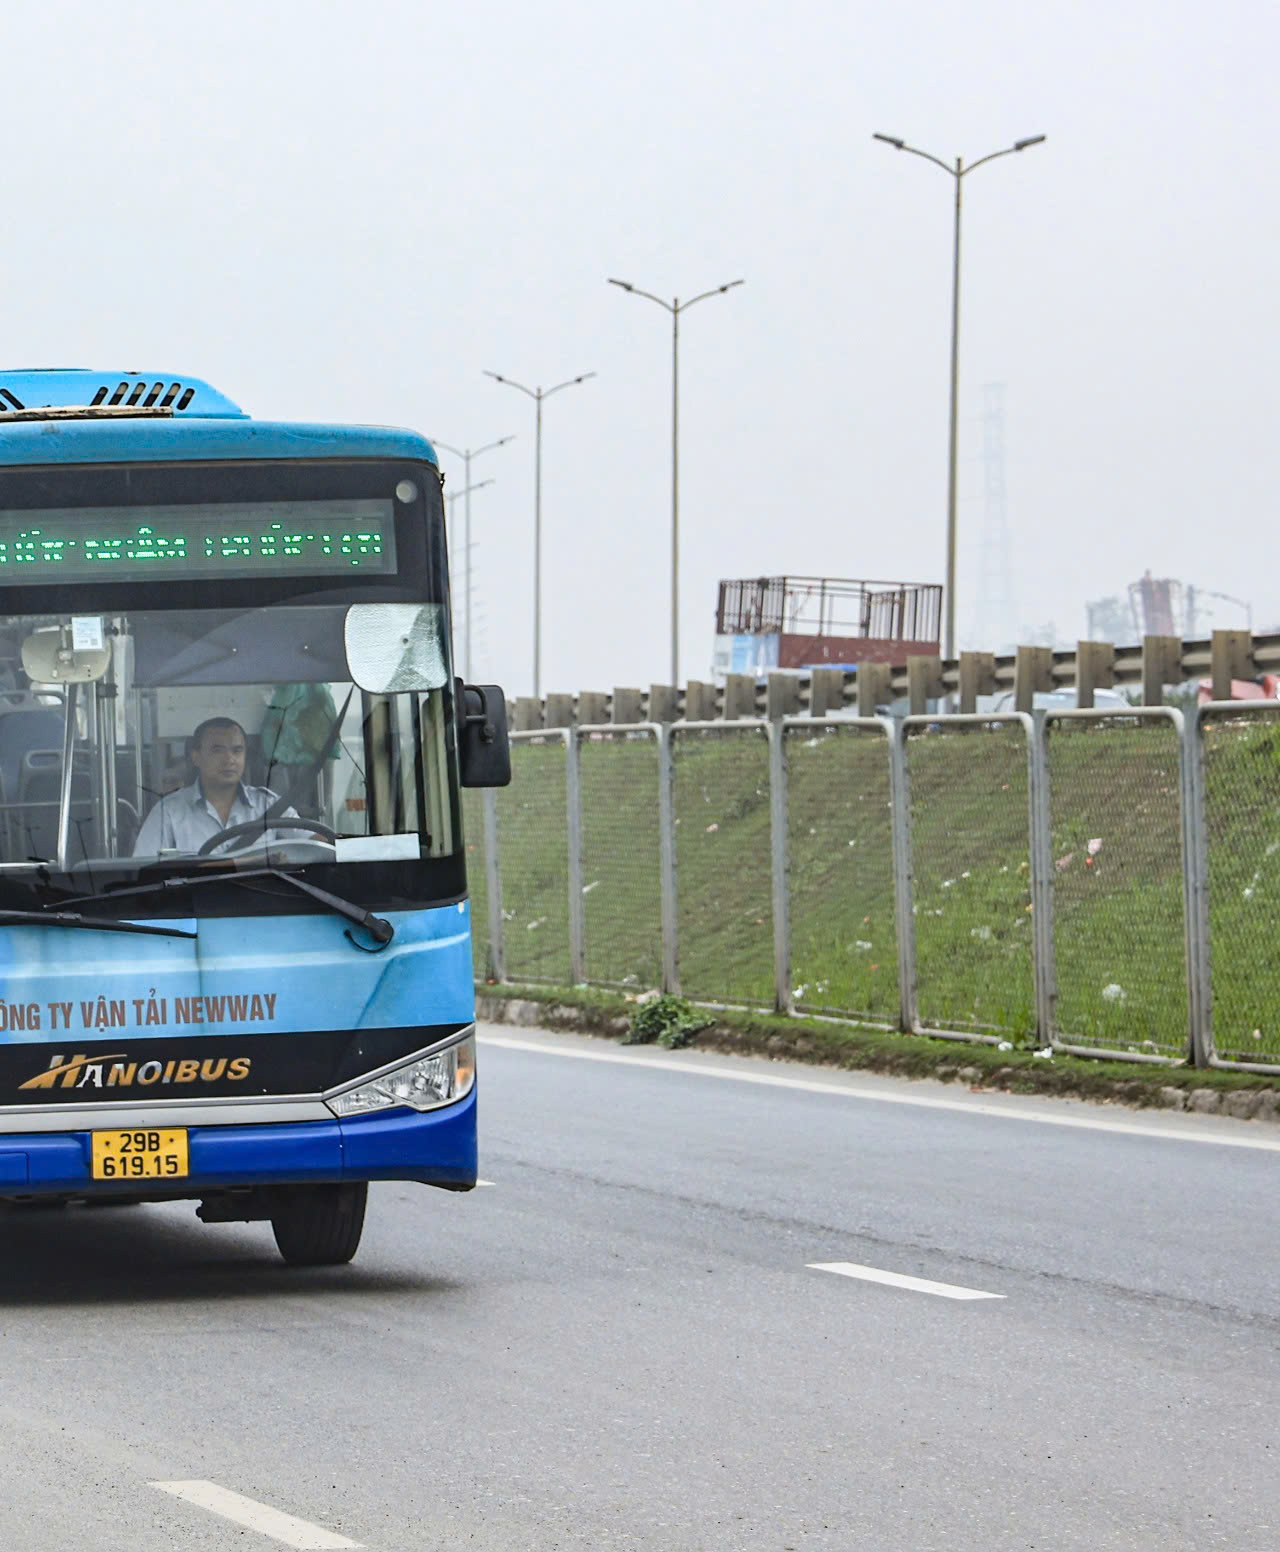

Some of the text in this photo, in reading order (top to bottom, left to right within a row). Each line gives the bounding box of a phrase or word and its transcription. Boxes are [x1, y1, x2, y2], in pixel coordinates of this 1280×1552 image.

[48, 1001, 74, 1029] TY
[81, 995, 126, 1032] VẬN
[132, 988, 167, 1026] TẢI
[175, 993, 277, 1024] NEWWAY
[18, 1054, 252, 1090] HANOIBUS
[120, 1132, 160, 1153] 29B
[103, 1154, 178, 1177] 619.15
